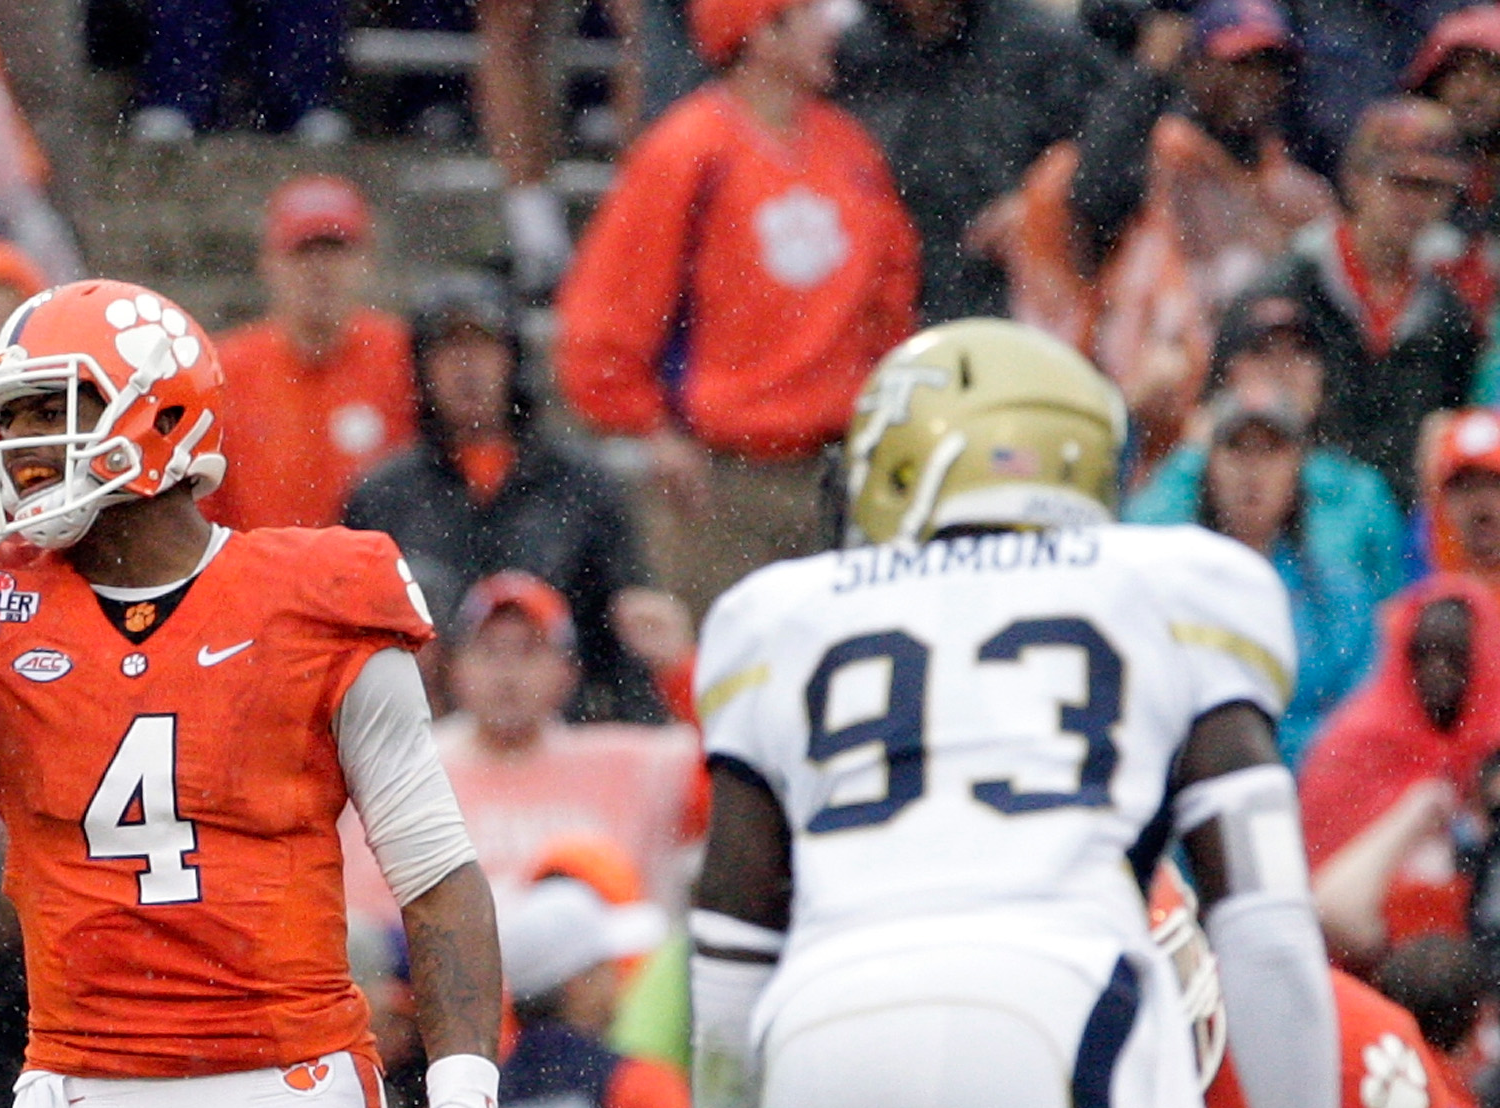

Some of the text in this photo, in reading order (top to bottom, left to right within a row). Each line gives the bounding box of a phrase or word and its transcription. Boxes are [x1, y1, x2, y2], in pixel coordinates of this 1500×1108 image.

[832, 528, 1100, 594] SIMMONS
[22, 656, 62, 671] ACC
[802, 614, 1127, 838] 93
[81, 712, 202, 905] 4
